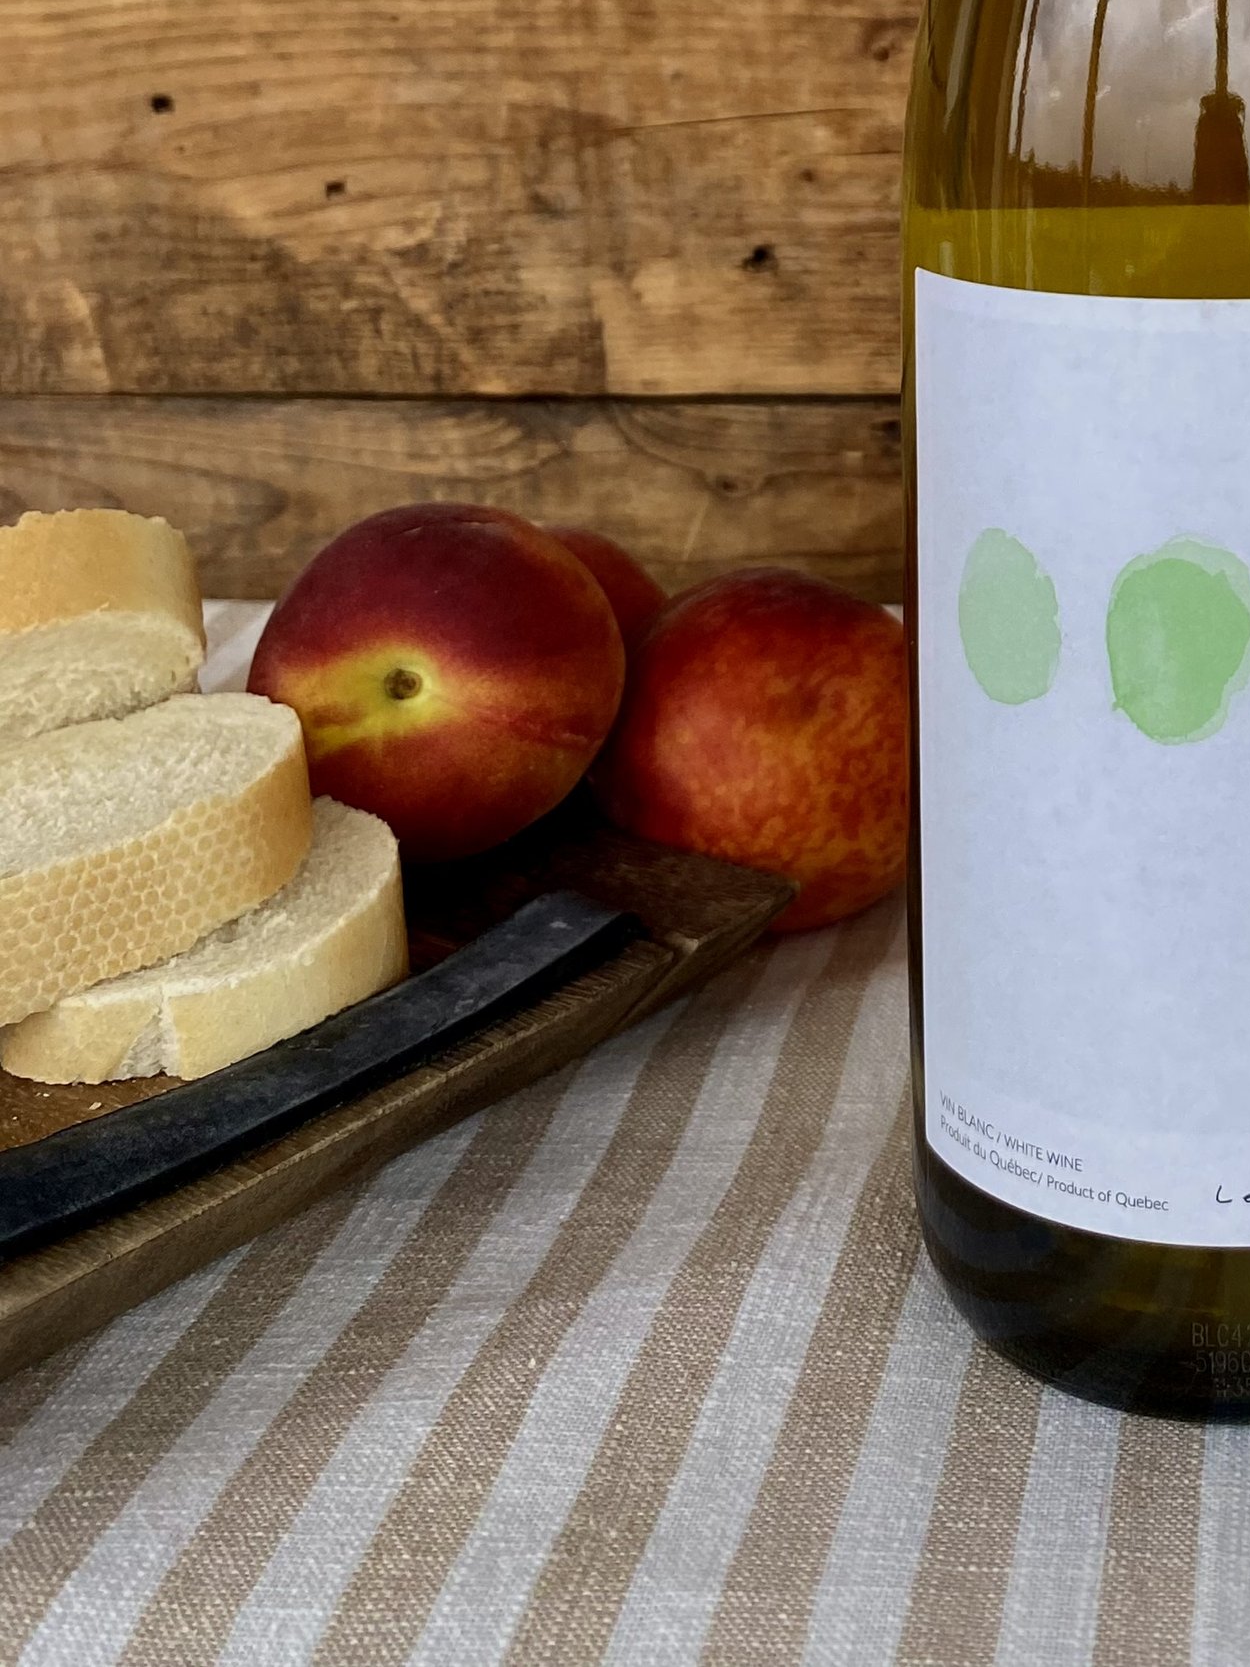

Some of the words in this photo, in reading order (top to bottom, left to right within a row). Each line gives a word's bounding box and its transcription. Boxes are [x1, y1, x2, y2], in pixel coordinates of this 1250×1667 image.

[939, 1090, 955, 1115] VIN
[957, 1105, 995, 1140] BLANC
[996, 1131, 1002, 1144] /
[1003, 1133, 1043, 1161] WHITE
[1046, 1149, 1083, 1172] WINE
[940, 1114, 972, 1151] Produit
[973, 1141, 987, 1160] du
[1046, 1174, 1095, 1200] Product
[1097, 1190, 1112, 1203] of
[1115, 1192, 1170, 1211] Quebec
